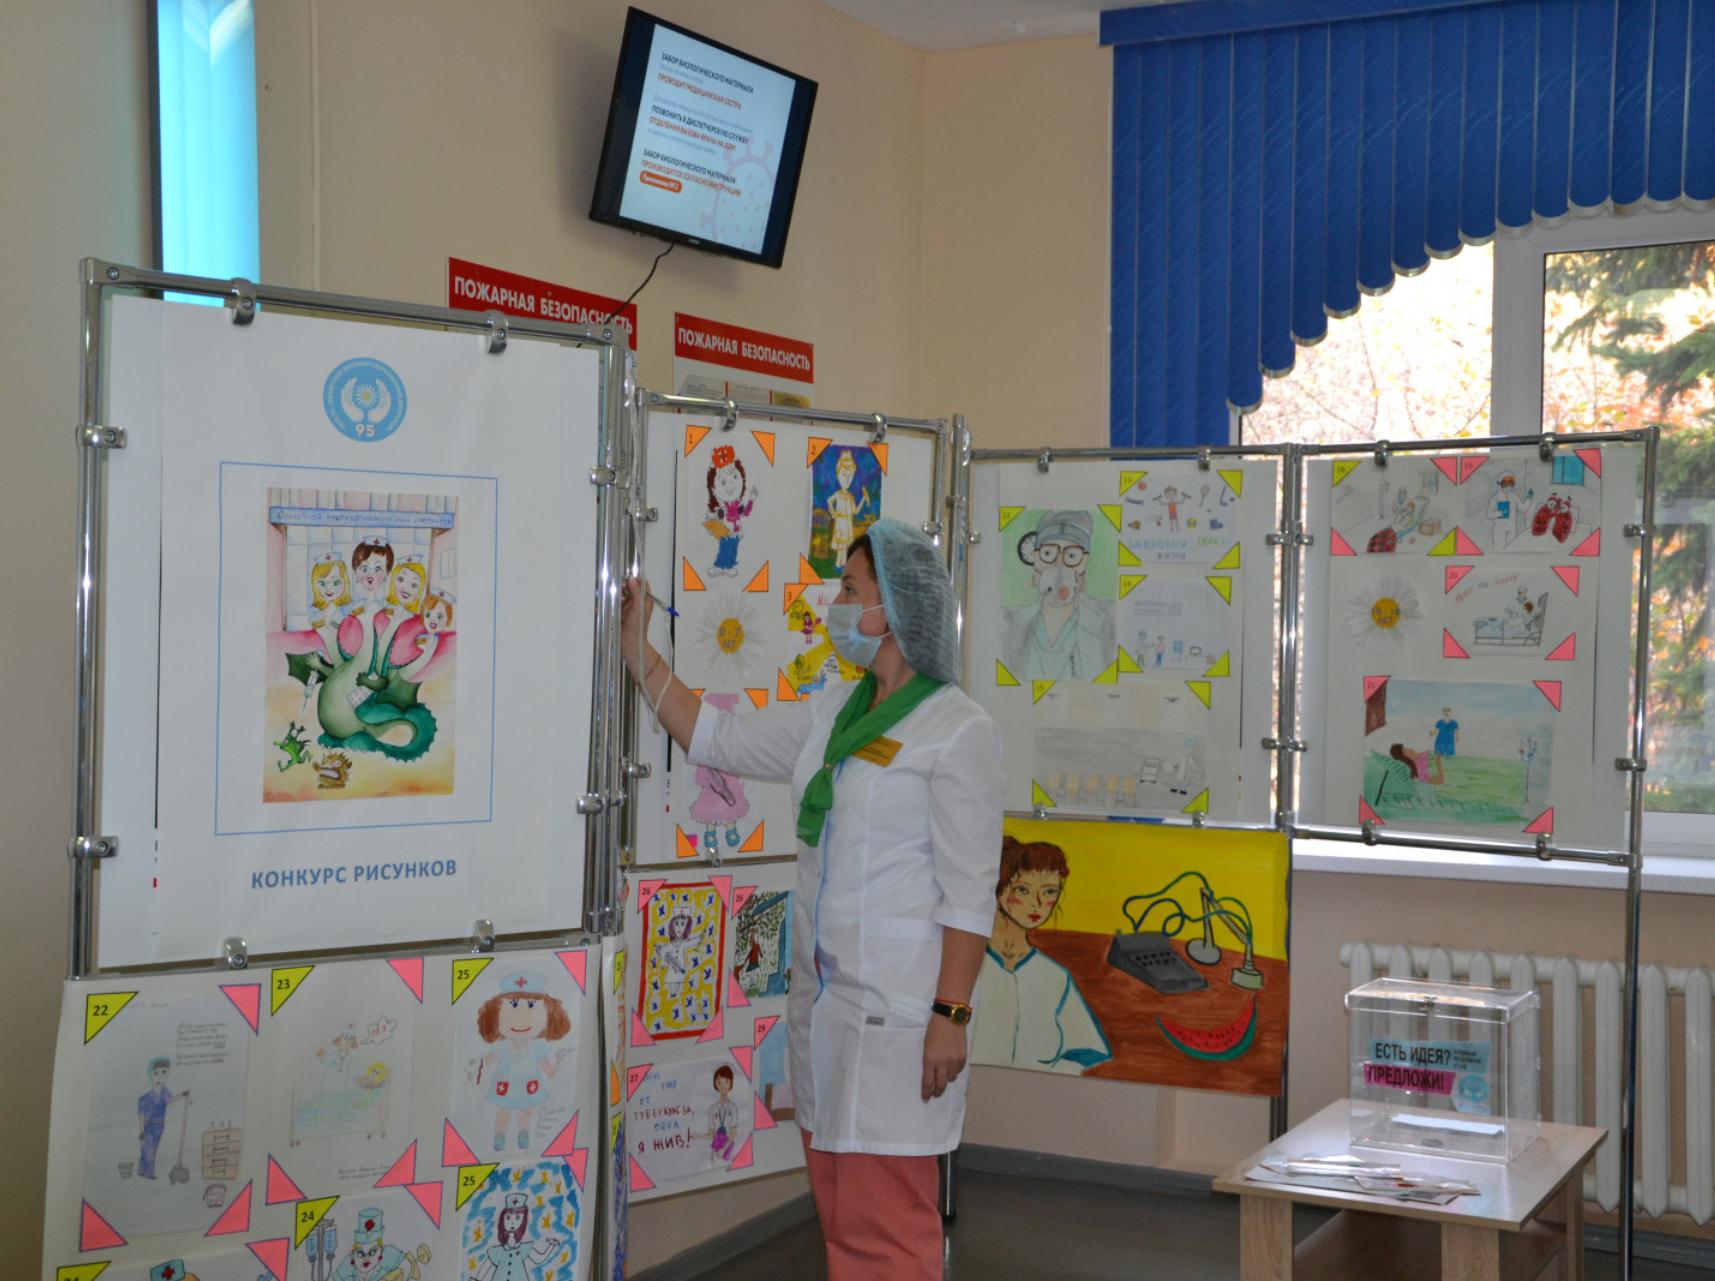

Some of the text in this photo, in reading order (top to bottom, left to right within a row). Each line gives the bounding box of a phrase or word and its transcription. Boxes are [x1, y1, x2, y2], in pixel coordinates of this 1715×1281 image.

[661, 52, 678, 64] ЗАБОР
[678, 58, 724, 82] БИОЛОГИЧЕСКОГО
[725, 76, 754, 93] МАТЕРИАЛА
[643, 148, 735, 183] ЗАБОР БИОЛОГИЧЕСКОГО МАТЕРИАЛА
[454, 275, 535, 312] ПОЖАРНАЯ
[678, 327, 810, 371] ПОЖАРНАЯ БЕЗОПАСНОСТЬ
[355, 423, 376, 437] 95
[251, 859, 457, 889] КОНКУРС РИСУНКОВ
[276, 979, 290, 990] 23
[457, 969, 470, 980] 25
[92, 1004, 108, 1017] 22
[1375, 1042, 1451, 1067] ЕСТЬ ИДЕЯ?
[1367, 1065, 1444, 1090] ПРЕДЛОЖИ!
[653, 1126, 690, 1151] ЖИВ!
[462, 1175, 476, 1186] 25
[301, 1211, 314, 1222] 24
